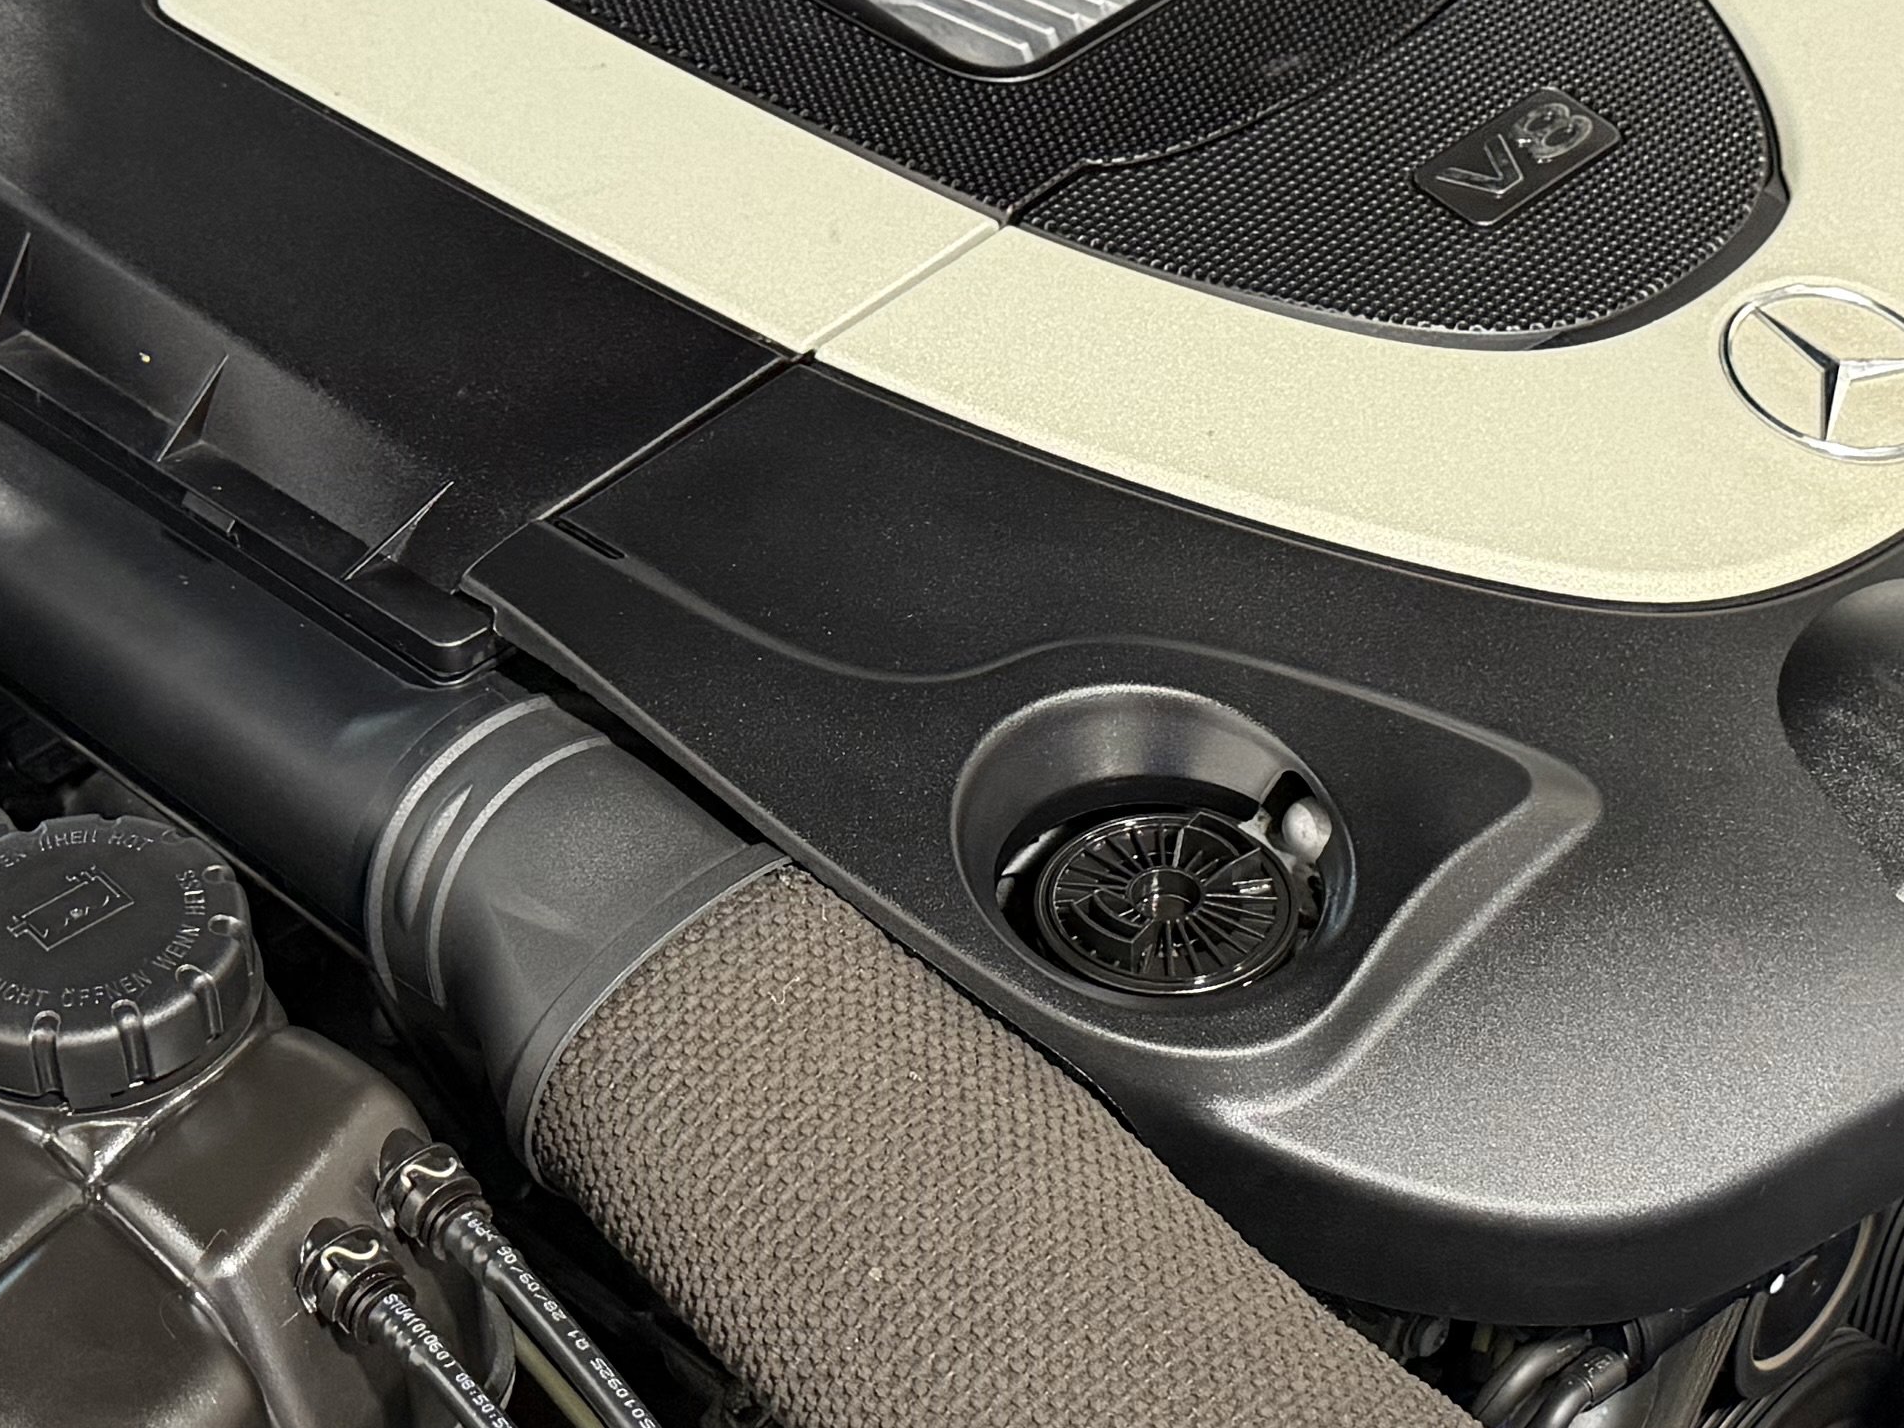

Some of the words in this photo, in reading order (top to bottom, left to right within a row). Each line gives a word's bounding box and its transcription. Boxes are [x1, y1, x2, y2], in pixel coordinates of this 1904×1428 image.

[1435, 102, 1596, 199] V8
[108, 833, 154, 851] HOT
[152, 924, 200, 971] WENN
[495, 1242, 568, 1324] 28/09/06
[565, 1326, 591, 1352] Q1
